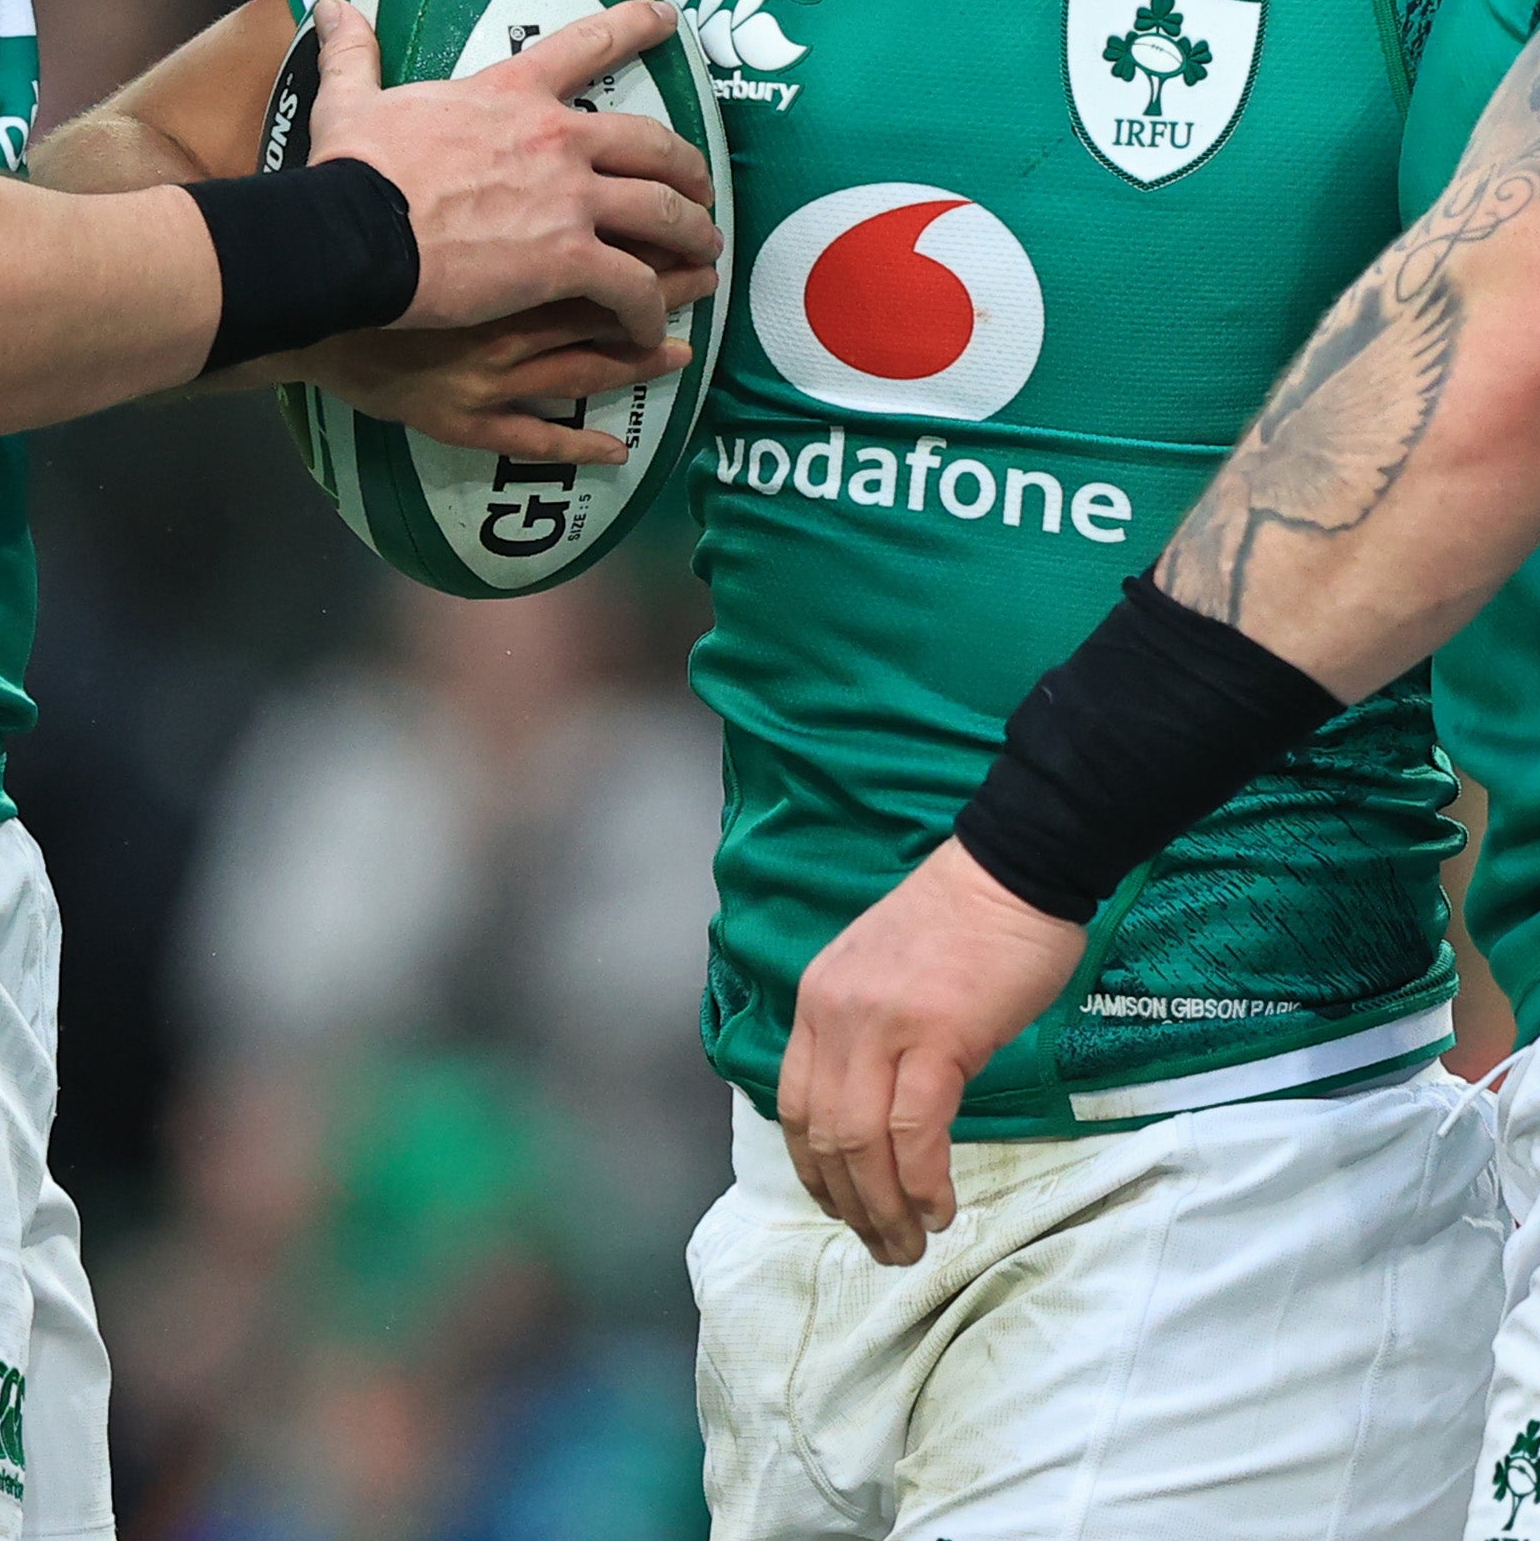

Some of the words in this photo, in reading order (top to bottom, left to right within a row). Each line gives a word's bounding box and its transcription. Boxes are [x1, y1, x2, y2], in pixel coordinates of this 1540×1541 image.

[710, 69, 800, 112] erbury
[263, 88, 298, 173] ONS
[1112, 118, 1195, 149] IRFU
[715, 425, 1133, 543] vodafone
[568, 512, 587, 542] SIZE
[579, 493, 592, 503] 5
[1079, 994, 1168, 1019] JAMISON
[1170, 997, 1249, 1020] GIBSON
